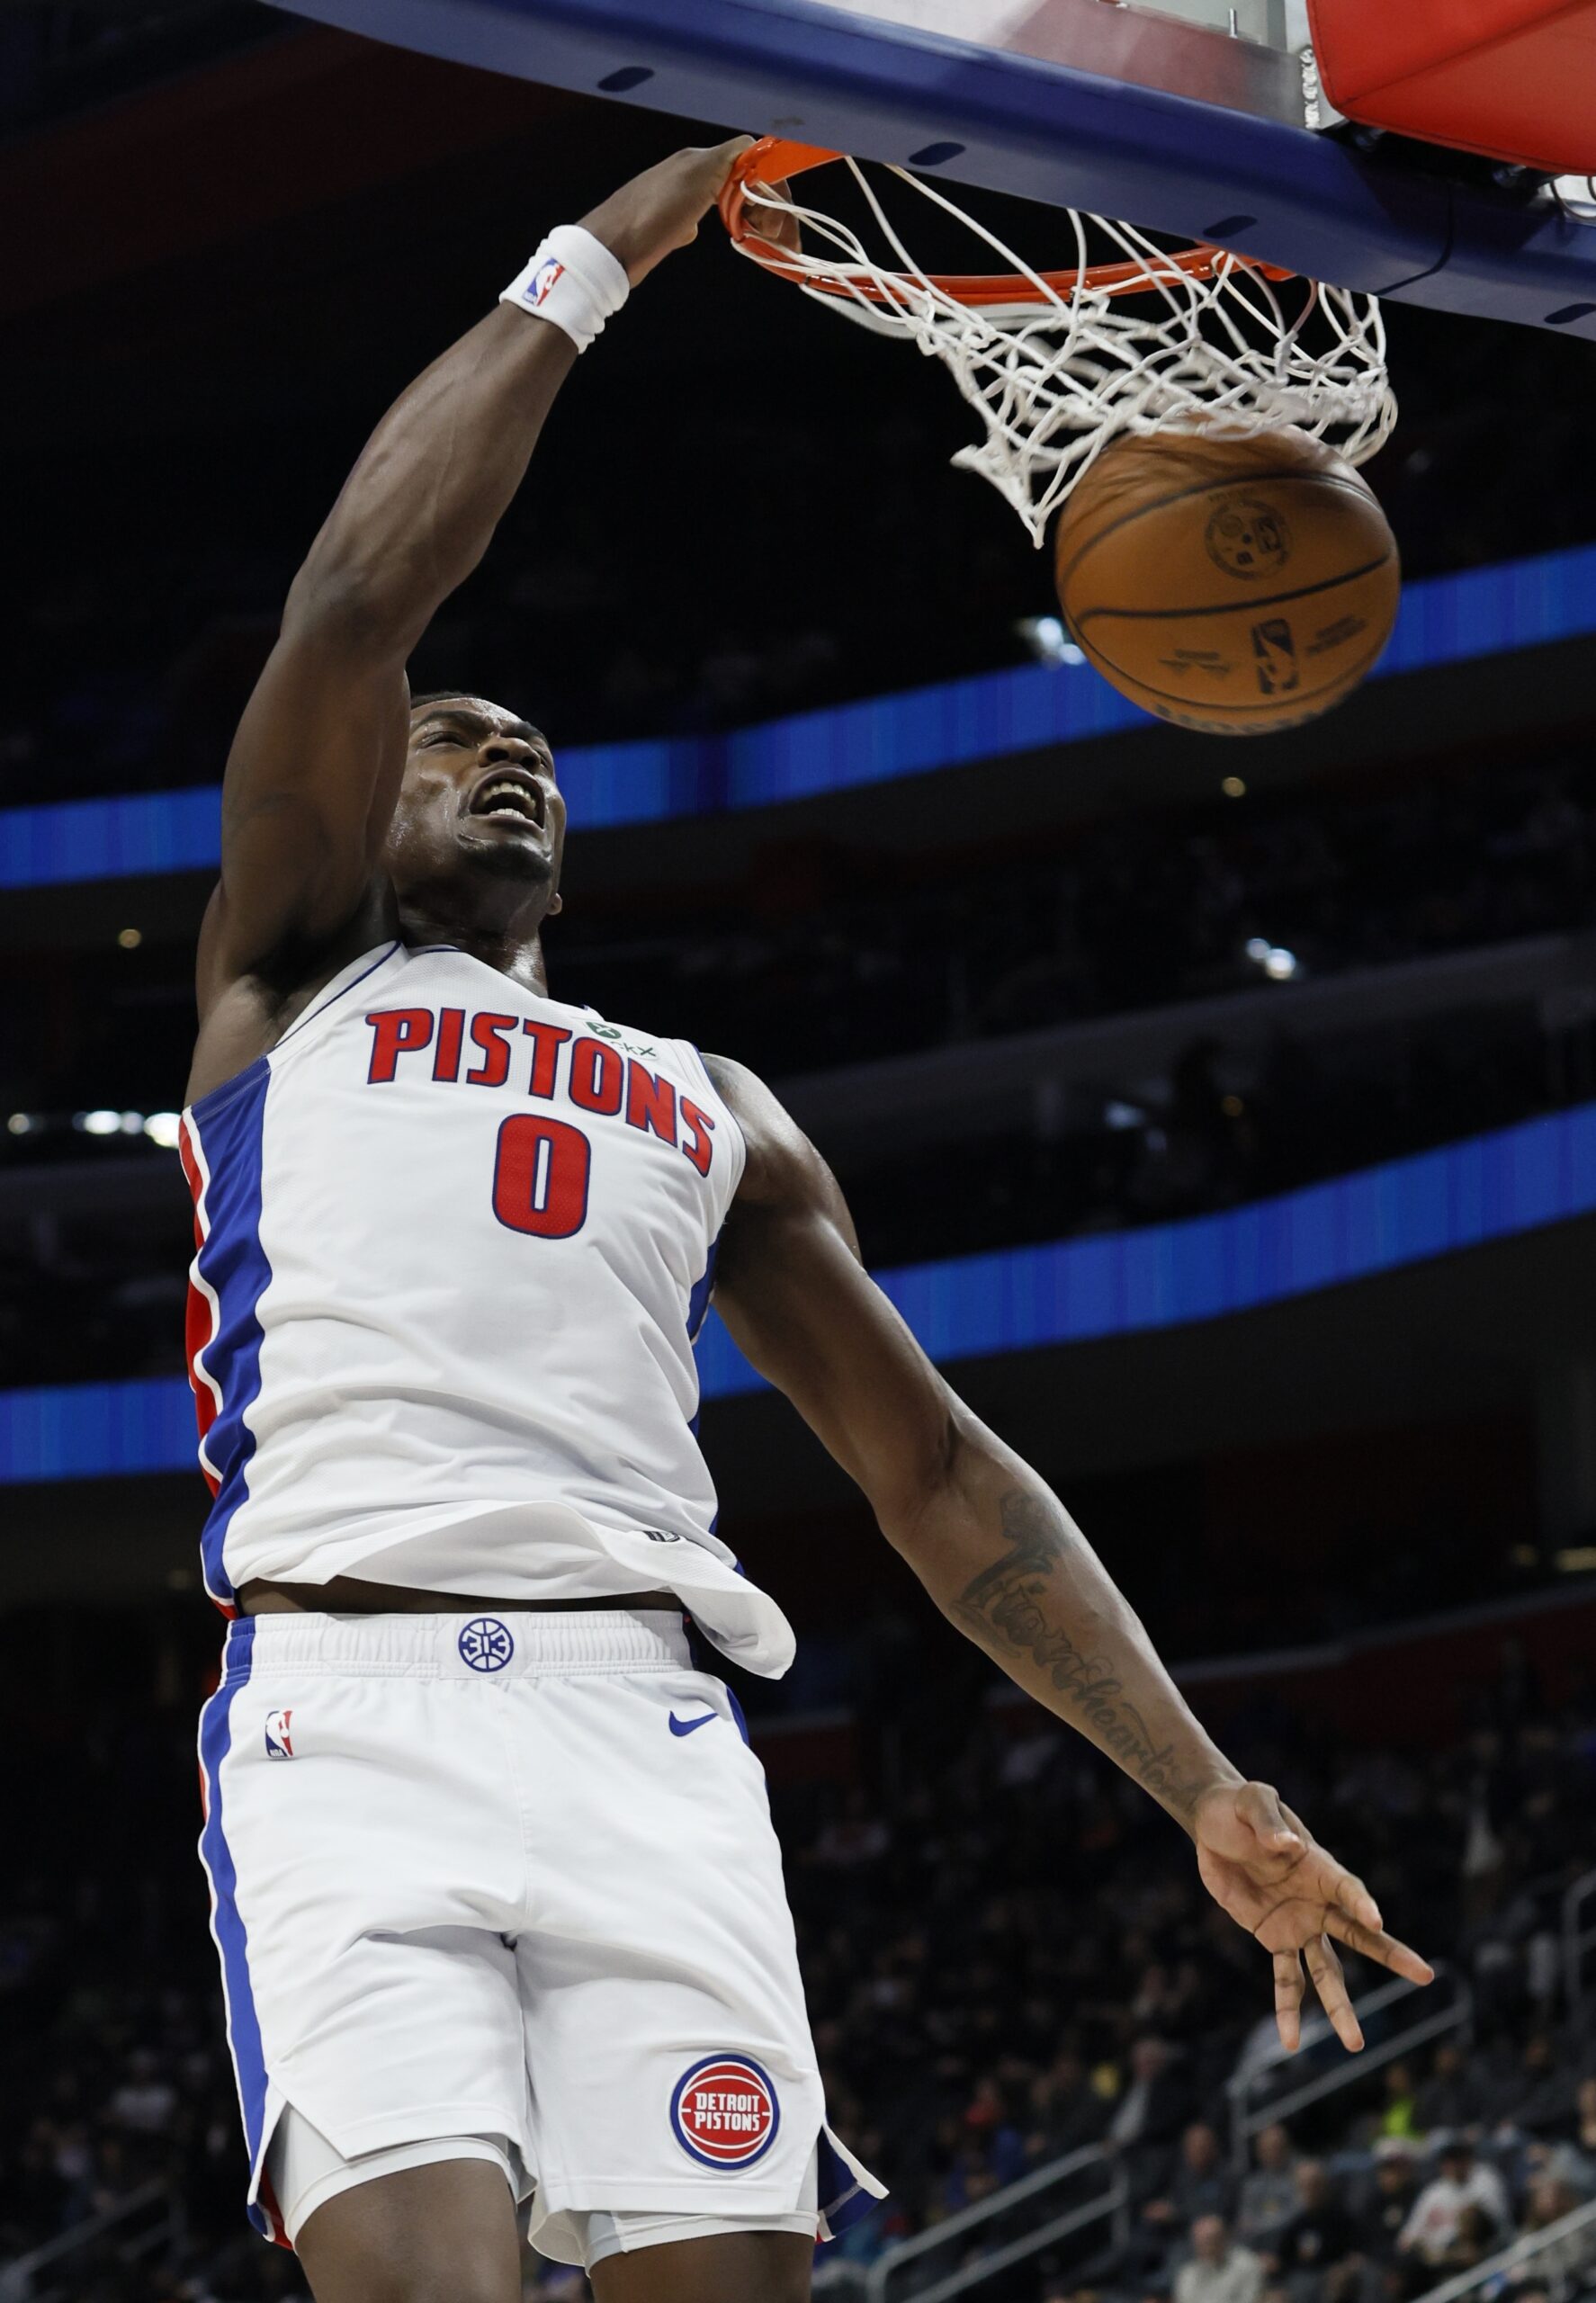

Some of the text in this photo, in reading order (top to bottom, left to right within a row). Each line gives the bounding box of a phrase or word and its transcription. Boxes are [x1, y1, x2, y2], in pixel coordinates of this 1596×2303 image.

[365, 1008, 715, 1178] PISTONS
[492, 1114, 591, 1240] 0
[694, 2111, 760, 2132] PISTONS
[695, 2092, 760, 2112] DETROIT
